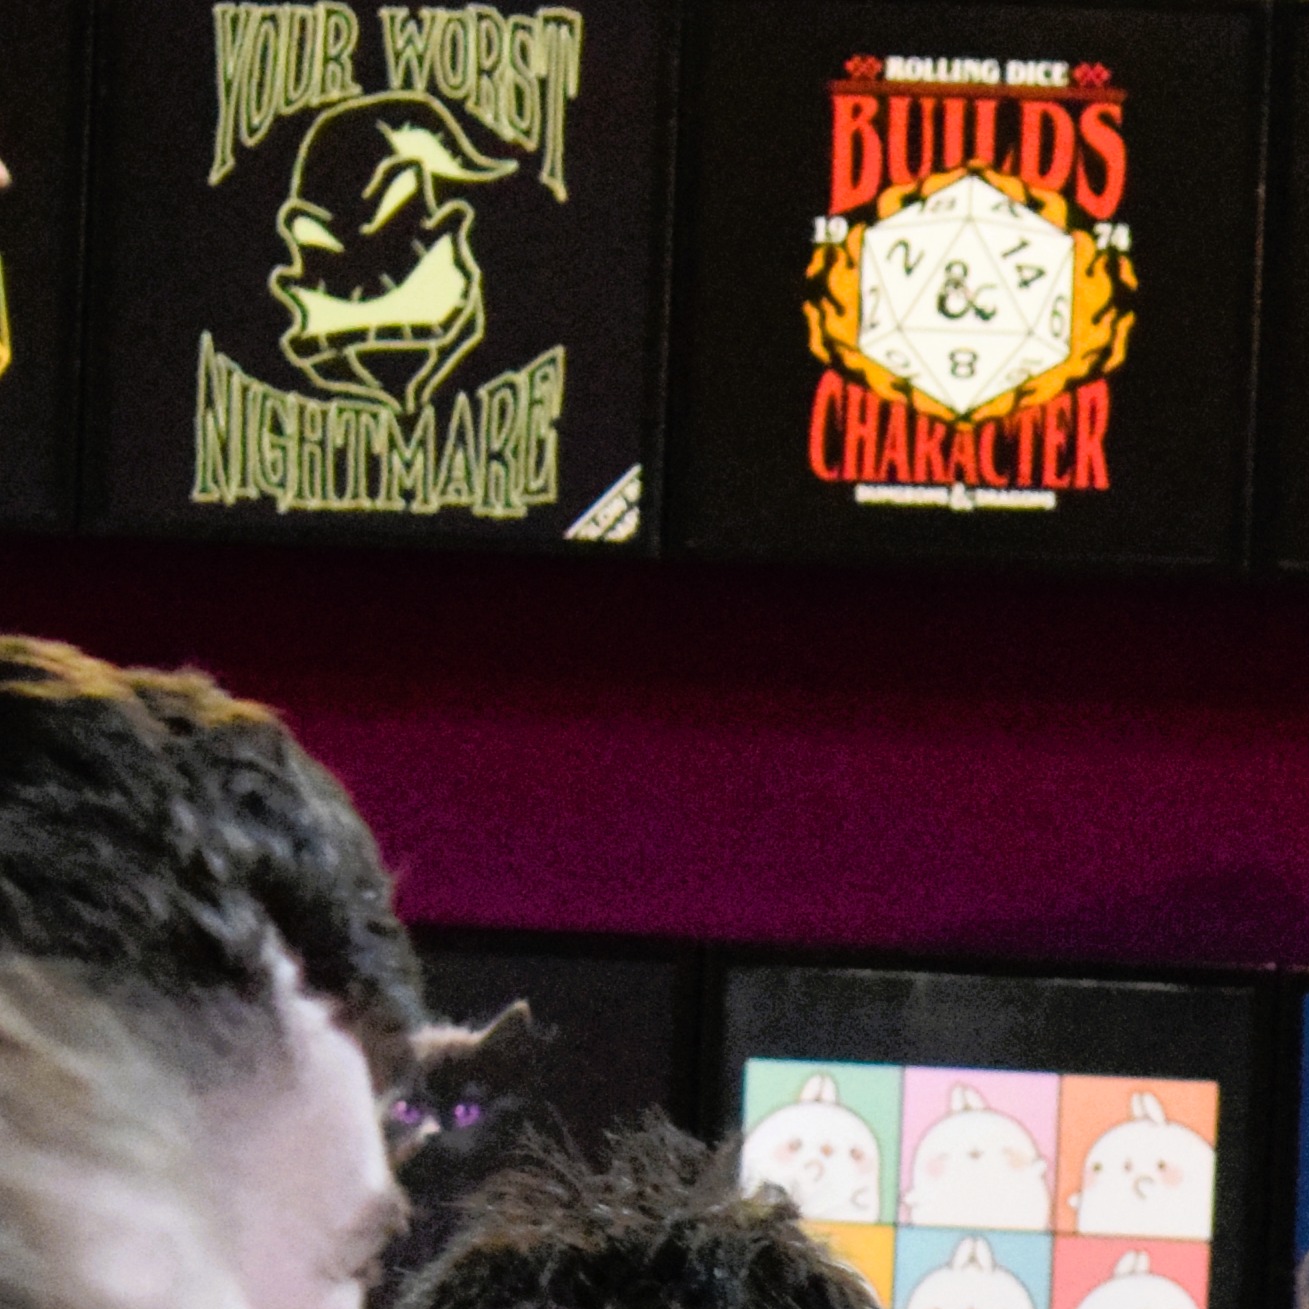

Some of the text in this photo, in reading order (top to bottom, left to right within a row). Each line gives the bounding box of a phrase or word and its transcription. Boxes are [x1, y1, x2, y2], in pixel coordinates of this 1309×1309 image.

[208, 3, 583, 202] YOUR WORST
[885, 55, 1069, 87] ROLLING DICE
[829, 95, 1127, 220] BUILDS
[812, 217, 1131, 252] 19 74
[190, 330, 567, 517] NIGHTMARE
[808, 369, 1109, 490] CHARACTER
